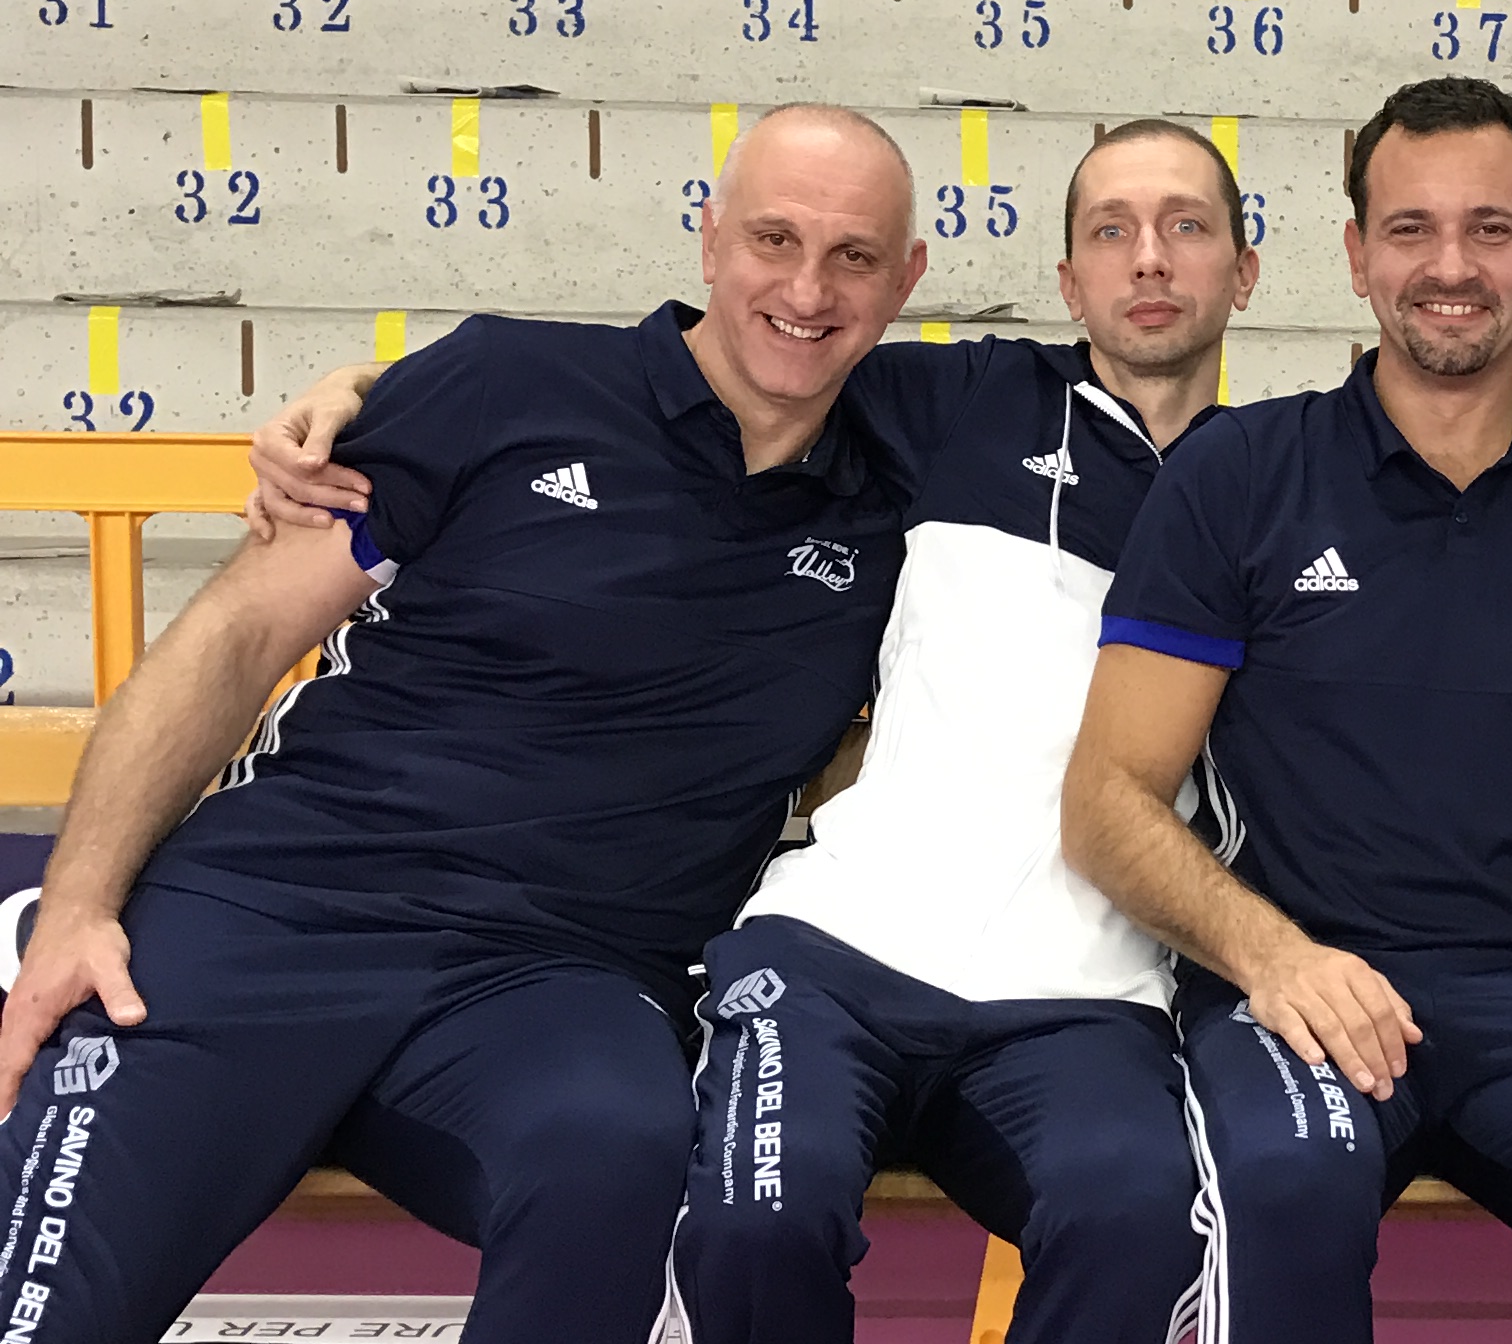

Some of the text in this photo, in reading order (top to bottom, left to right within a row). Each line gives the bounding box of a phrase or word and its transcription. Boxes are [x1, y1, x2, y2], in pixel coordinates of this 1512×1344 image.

[1206, 5, 1284, 57] 36
[174, 169, 261, 226] 32
[425, 174, 510, 230] 33
[934, 184, 1020, 239] 35
[529, 477, 599, 510] adidas
[1294, 573, 1360, 593] adidas
[751, 1017, 784, 1079] SAVINO
[36, 1106, 58, 1143] Global
[755, 1081, 784, 1120] DEL
[44, 1105, 96, 1208] SAVINO
[722, 1142, 737, 1205] Company
[27, 1216, 66, 1274] DEL
[217, 1321, 332, 1339] PER
